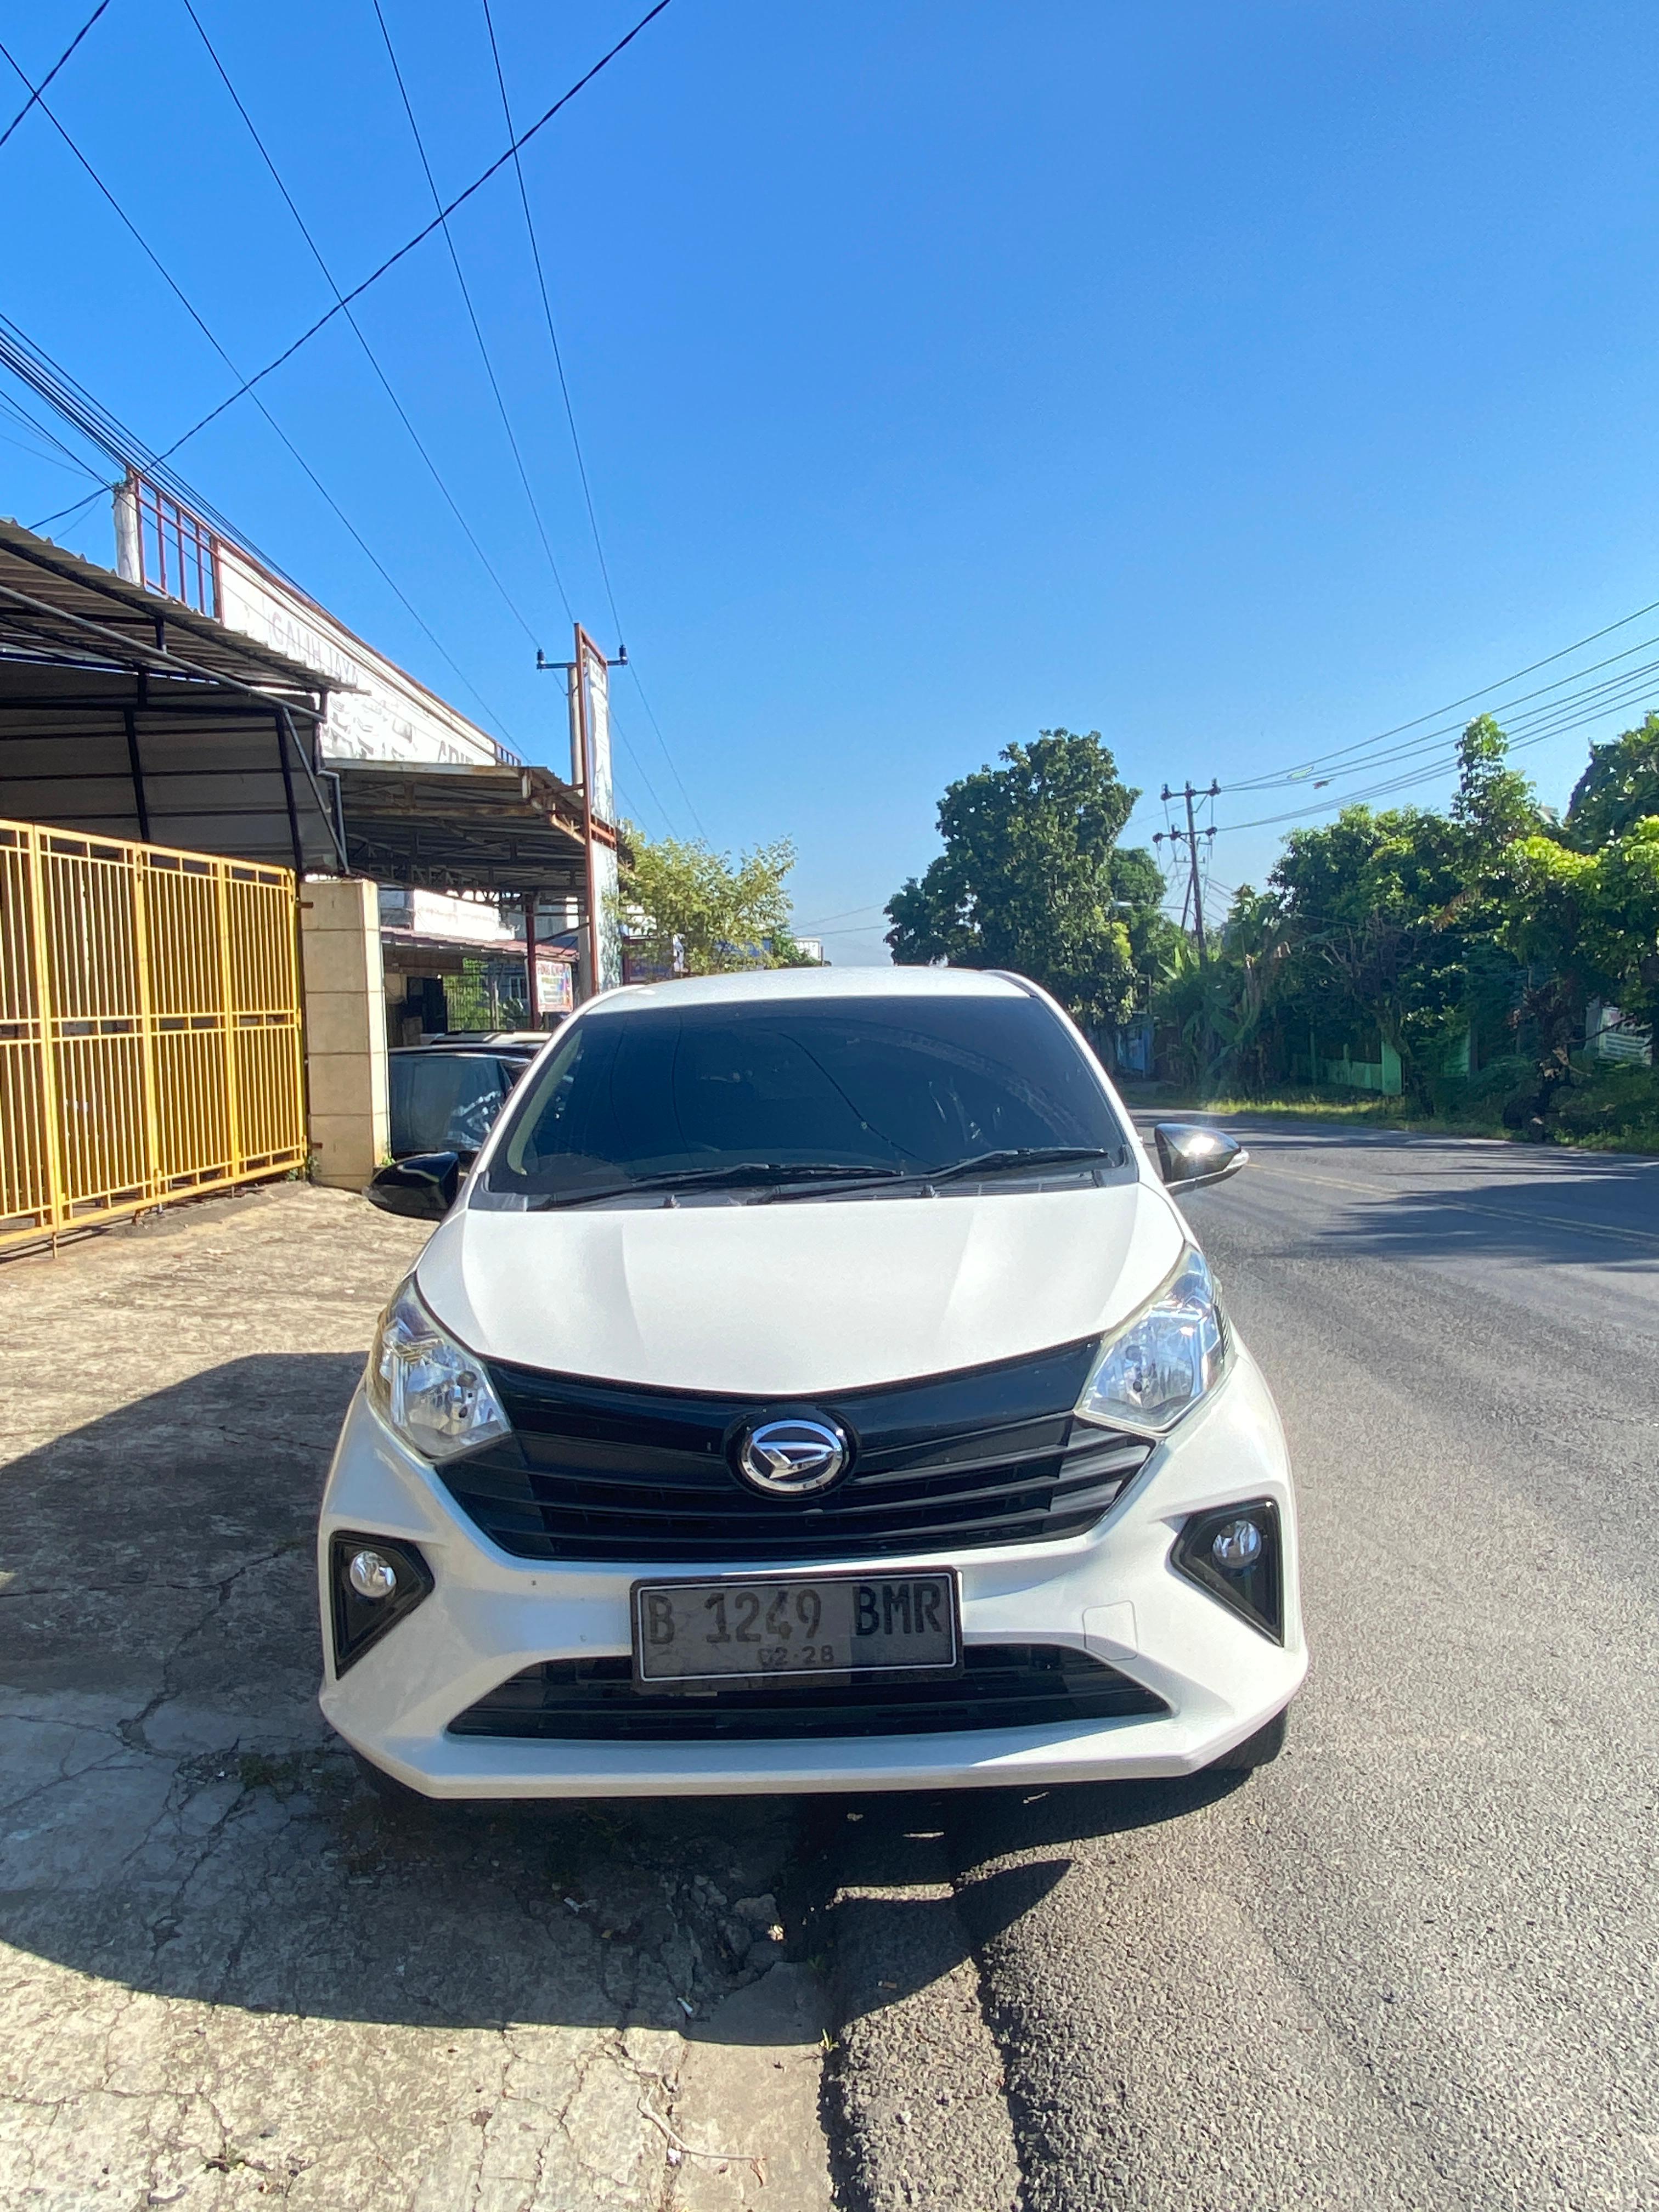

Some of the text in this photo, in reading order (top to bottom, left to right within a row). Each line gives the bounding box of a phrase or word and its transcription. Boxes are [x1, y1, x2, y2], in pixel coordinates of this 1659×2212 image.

[648, 1582, 942, 1645] B 1249 BMR
